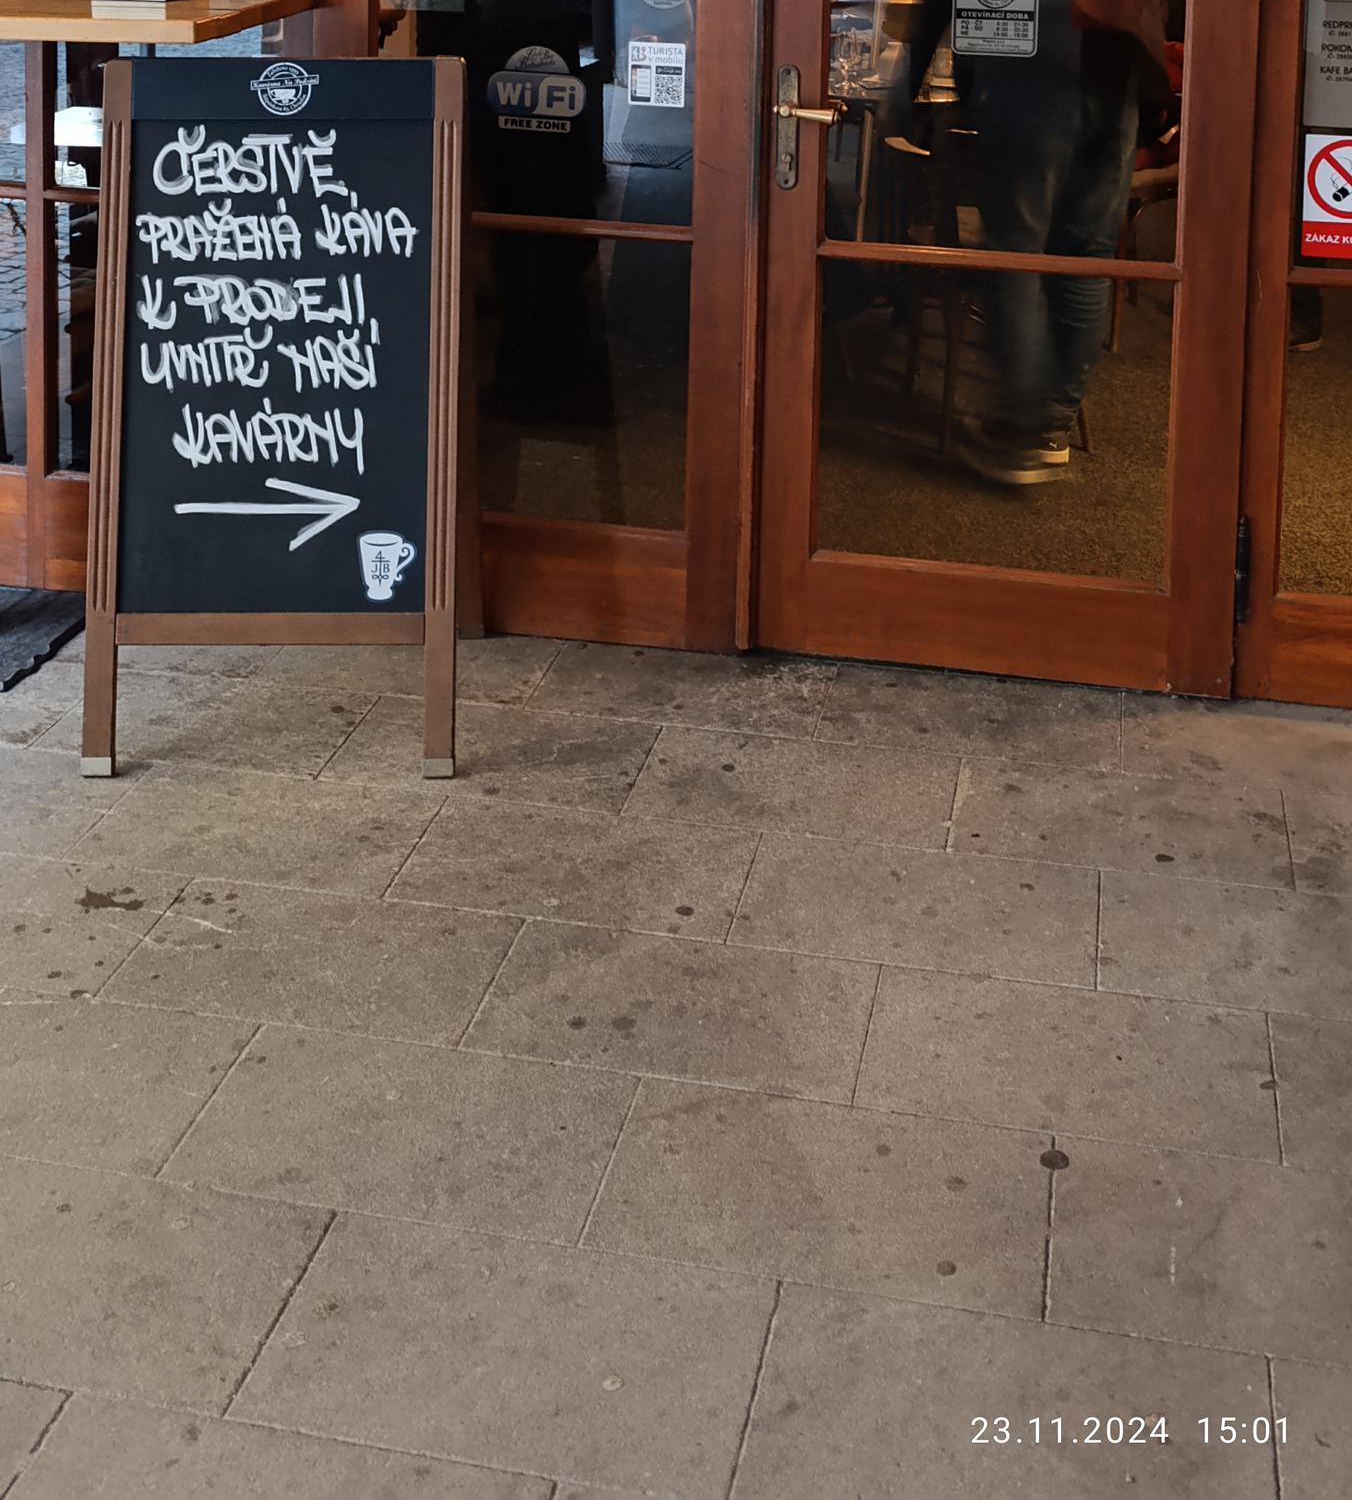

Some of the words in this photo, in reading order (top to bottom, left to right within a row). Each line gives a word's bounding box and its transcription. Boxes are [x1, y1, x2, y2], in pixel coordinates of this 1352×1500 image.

[961, 10, 1005, 19] OTEVÍRACÍ
[1006, 12, 1029, 20] DOBA
[1320, 65, 1340, 75] KAFE
[503, 118, 532, 129] FREE
[535, 120, 568, 131] ZONE
[152, 125, 348, 197] ČERSTVĚ
[135, 197, 302, 264] PRAŽENÁ
[315, 191, 420, 258] KÁVA
[136, 274, 177, 331] K
[174, 274, 366, 326] PRODEJI
[140, 324, 273, 393] UVNITŘ
[277, 318, 381, 393] NAŠÍ
[172, 397, 365, 476] KAVÁRNY
